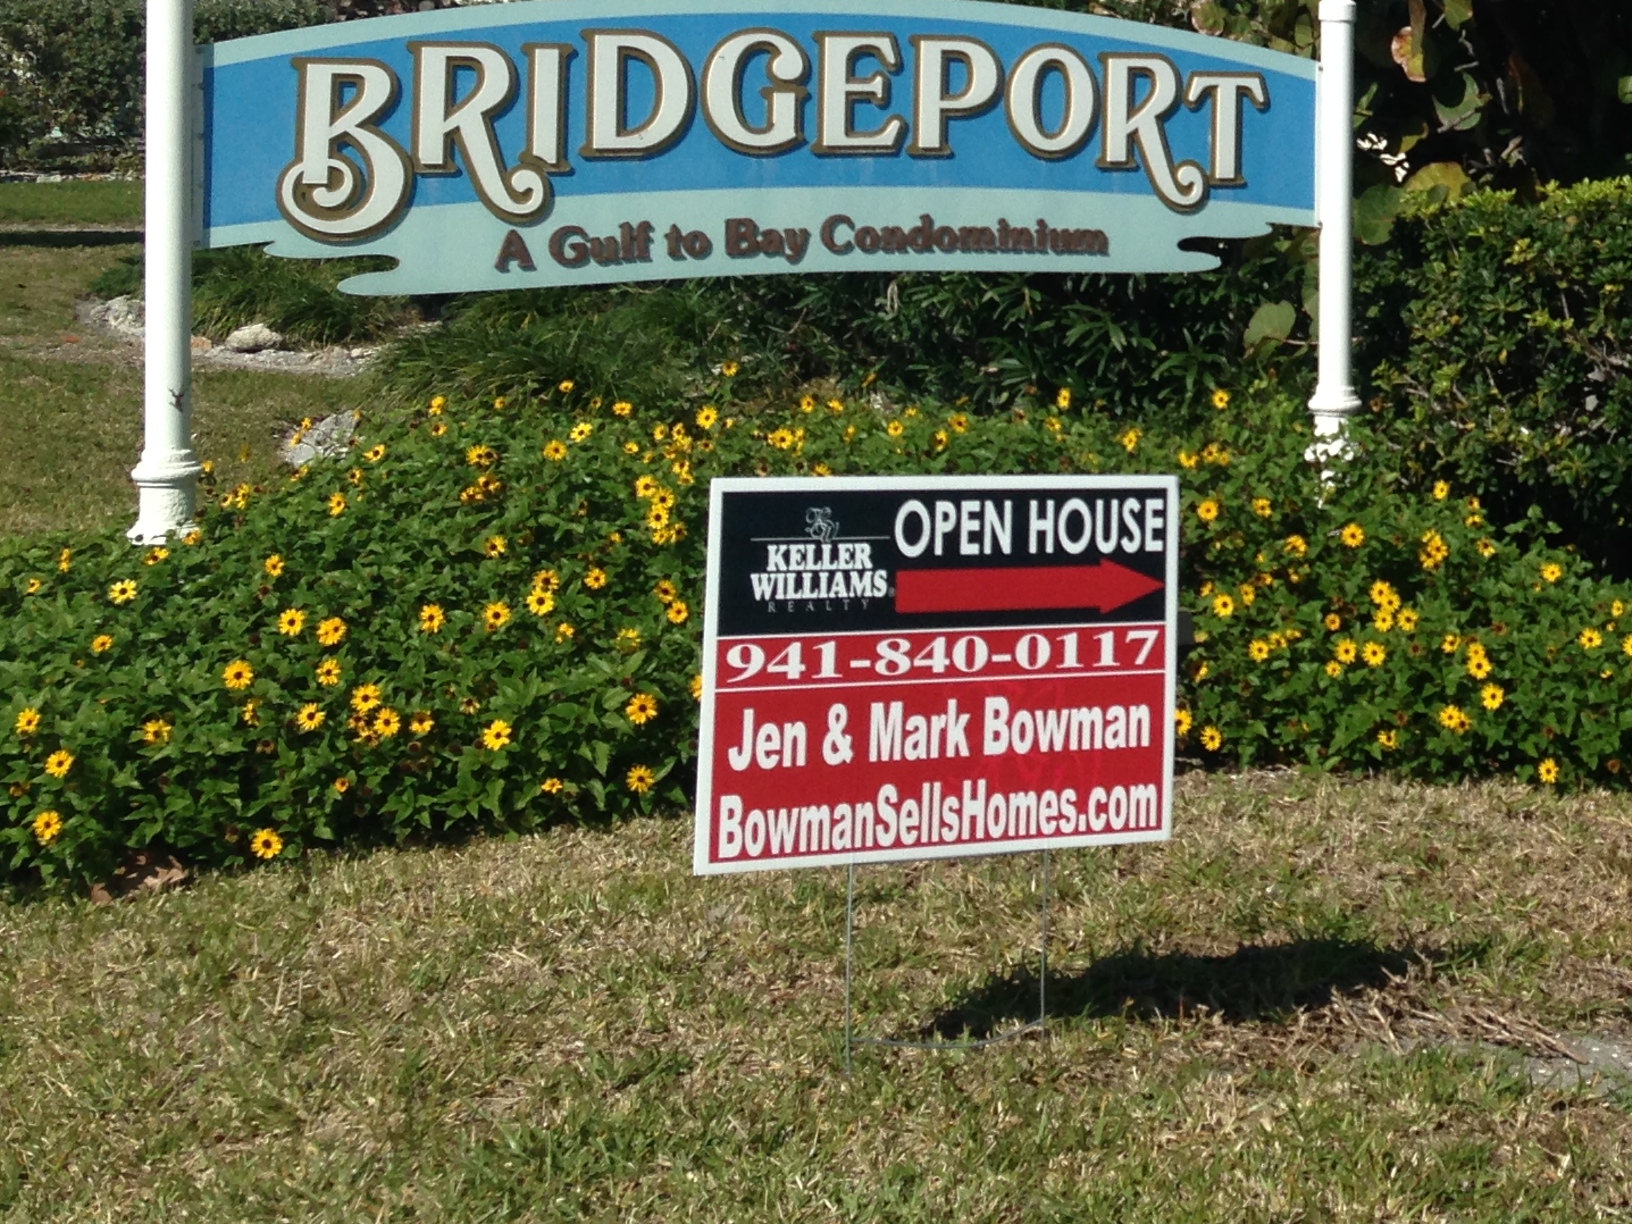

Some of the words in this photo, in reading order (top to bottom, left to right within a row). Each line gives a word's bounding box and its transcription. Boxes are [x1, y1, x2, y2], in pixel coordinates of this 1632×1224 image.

[276, 27, 1270, 242] BRIDGEPORT
[495, 229, 536, 272] A
[549, 220, 655, 266] Gulf
[664, 223, 713, 260] to
[724, 217, 810, 263] Bay
[820, 214, 1110, 257] Condominium
[894, 499, 1012, 558] OPEN
[1028, 497, 1166, 556] HOUSE
[750, 569, 888, 602] WILLIAMS
[766, 544, 873, 572] KELLER
[767, 599, 870, 614] REALTY
[725, 629, 1160, 684] 941-840-0117
[728, 708, 807, 772] Jen
[822, 702, 854, 766] &
[869, 698, 971, 763] Mark
[983, 696, 1151, 757] Bowman
[717, 778, 1158, 859] BowmanSellsHomes.com
